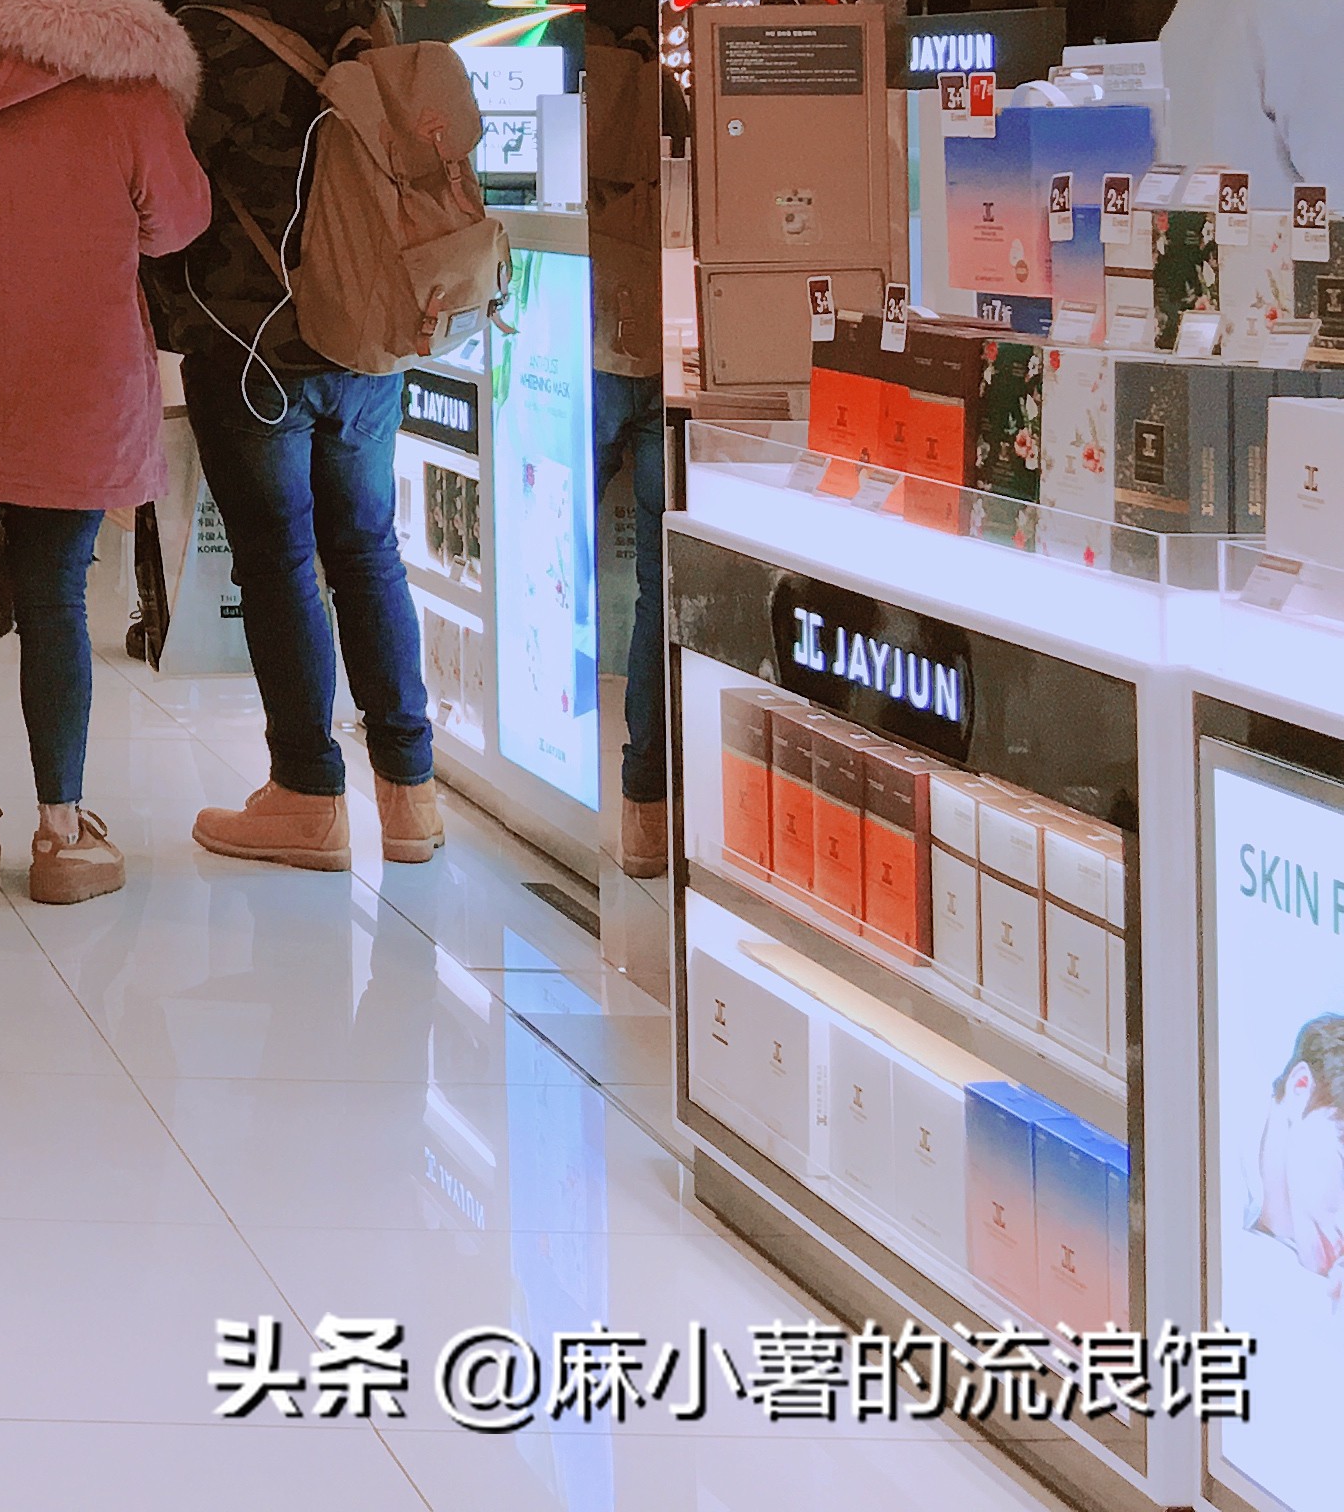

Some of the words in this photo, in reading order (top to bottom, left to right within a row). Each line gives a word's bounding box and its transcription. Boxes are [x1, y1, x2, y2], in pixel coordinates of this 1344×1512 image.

[910, 32, 995, 72] JAYJUN
[1107, 188, 1130, 213] 2+1
[1221, 186, 1248, 213] 3+3
[1296, 199, 1326, 227] 3+2
[423, 390, 469, 431] JAYJUN
[197, 545, 232, 553] KOREA
[832, 625, 961, 724] JAYJUN
[1239, 842, 1320, 927] SKIN
